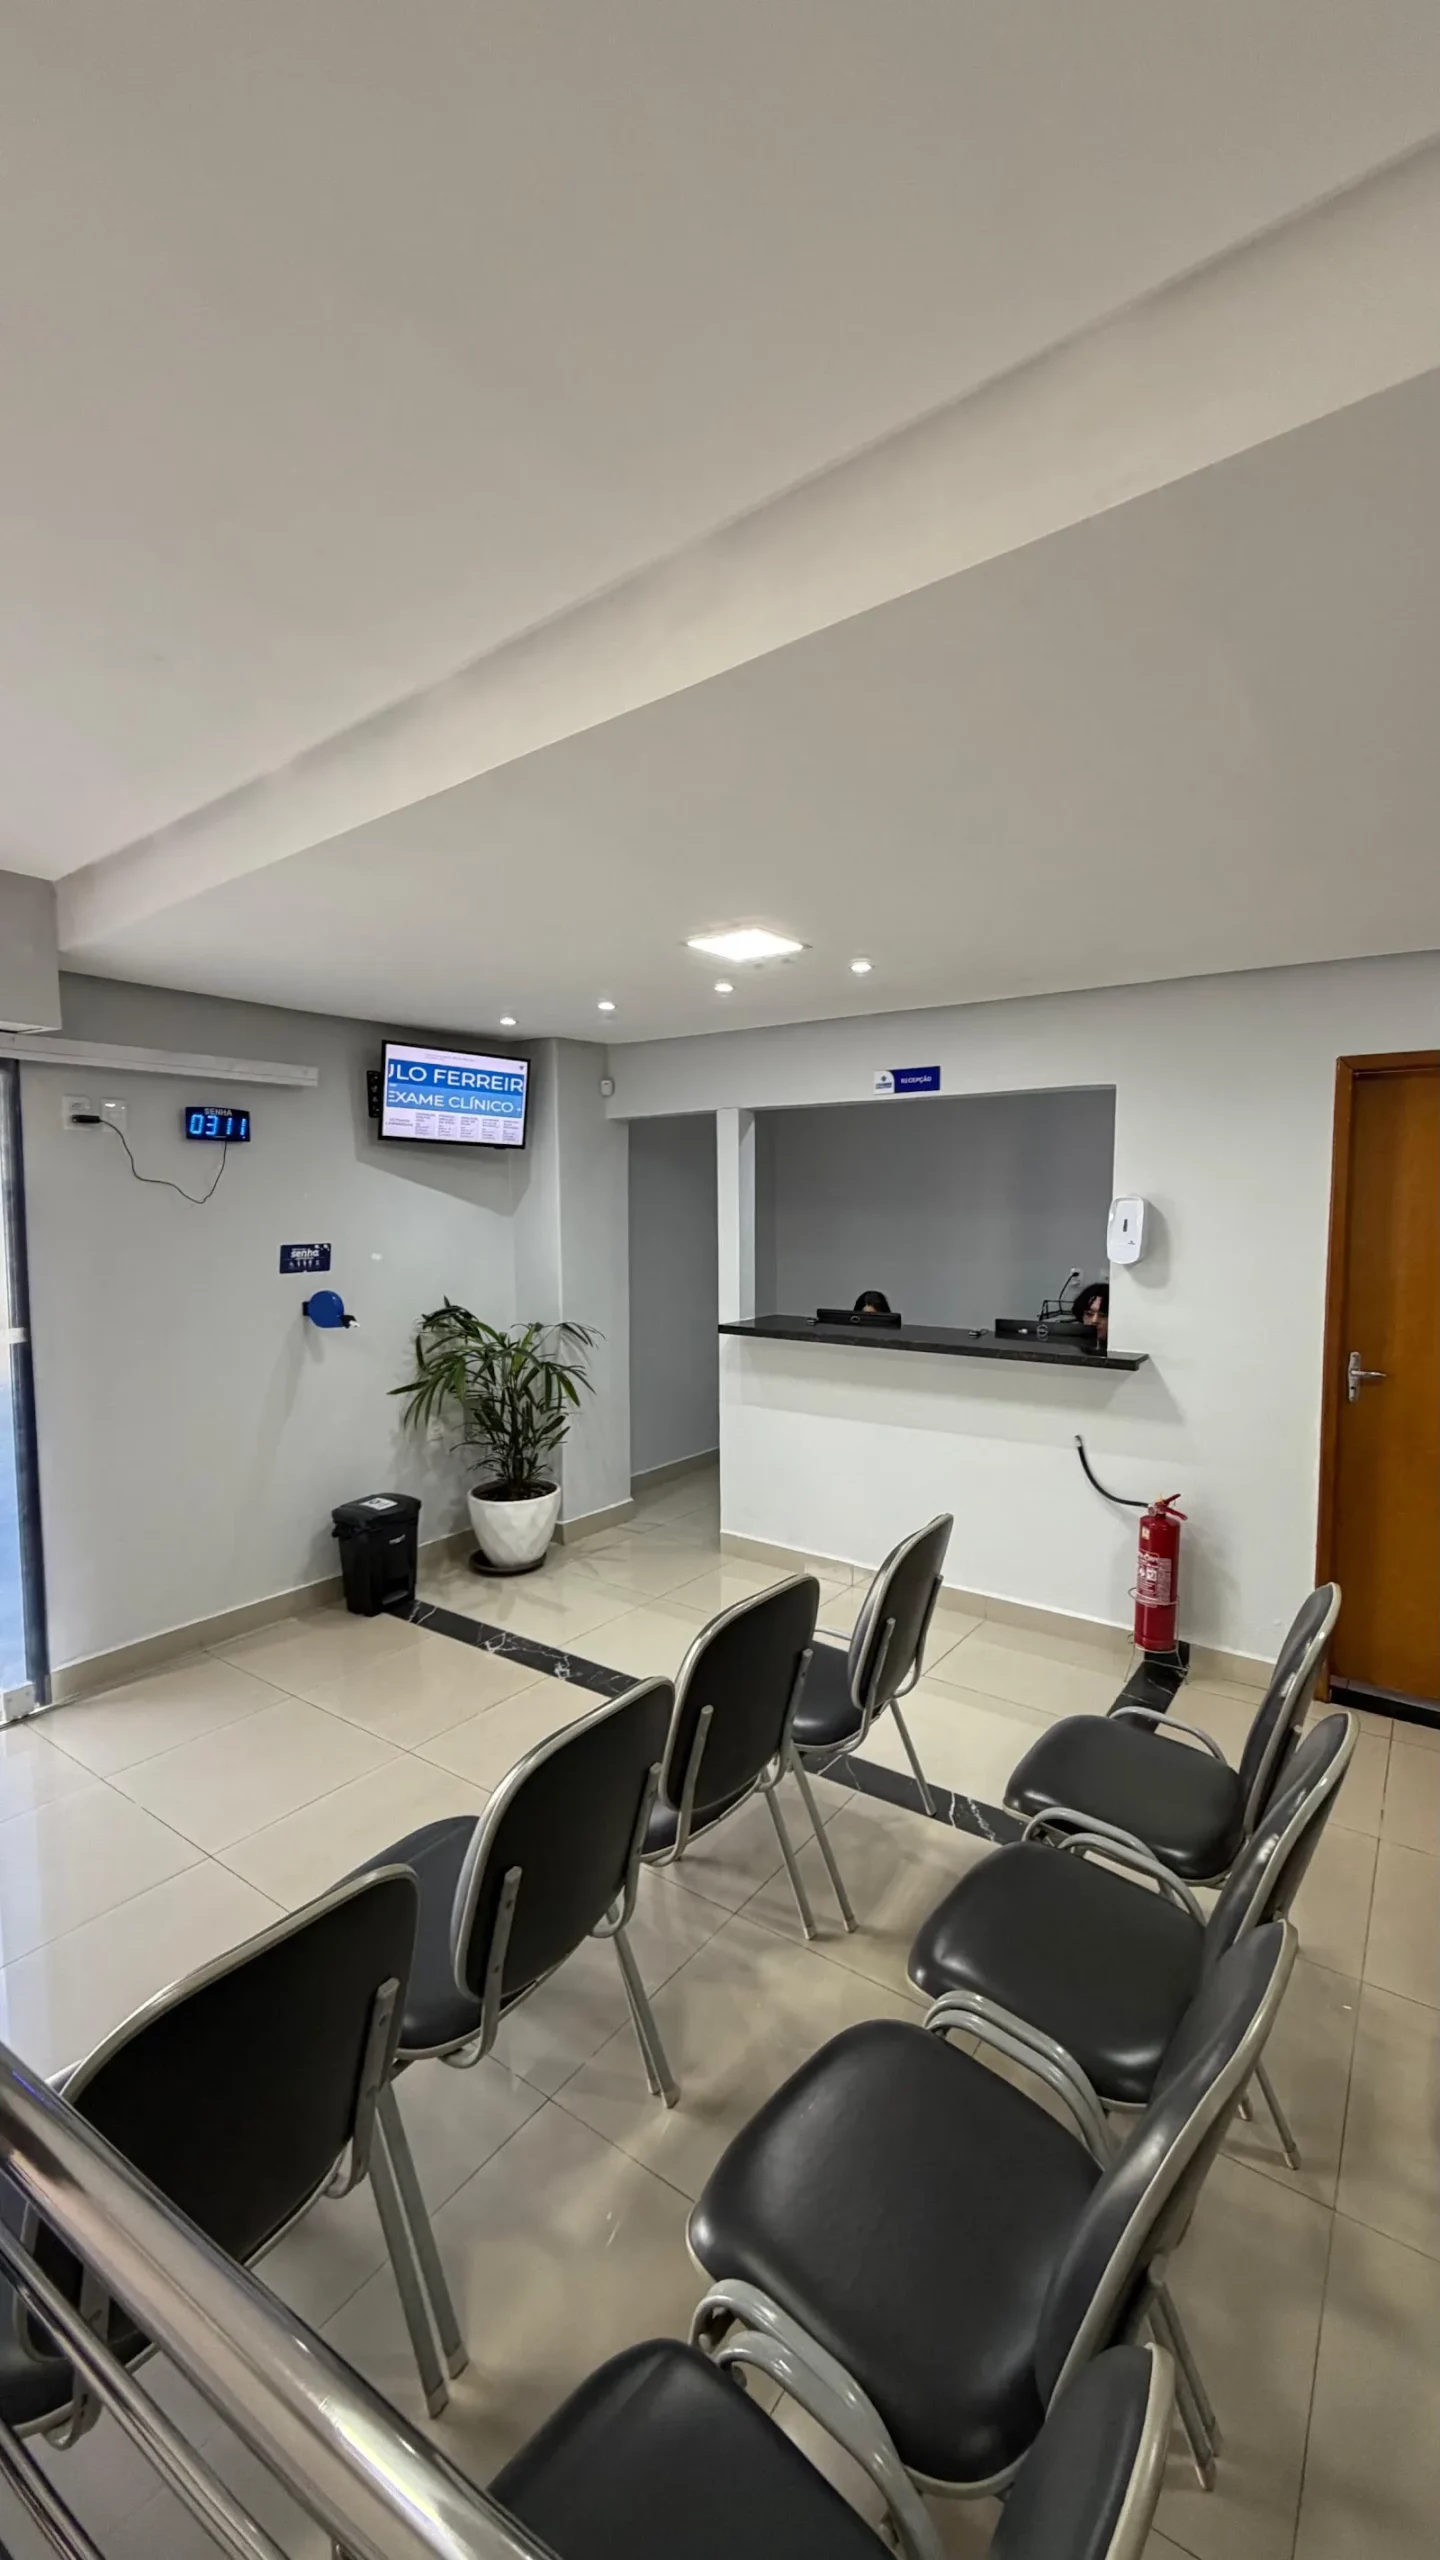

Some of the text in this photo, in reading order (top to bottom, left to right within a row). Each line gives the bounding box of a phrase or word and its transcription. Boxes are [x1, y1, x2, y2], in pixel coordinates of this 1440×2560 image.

[433, 1068, 524, 1093] FERREIR
[900, 1076, 932, 1084] RECEPÇÃO
[388, 1090, 514, 1113] EXAME CLÍNICO
[204, 1107, 233, 1116] SENHA
[190, 1114, 247, 1136] 0311
[291, 1248, 319, 1258] senha
